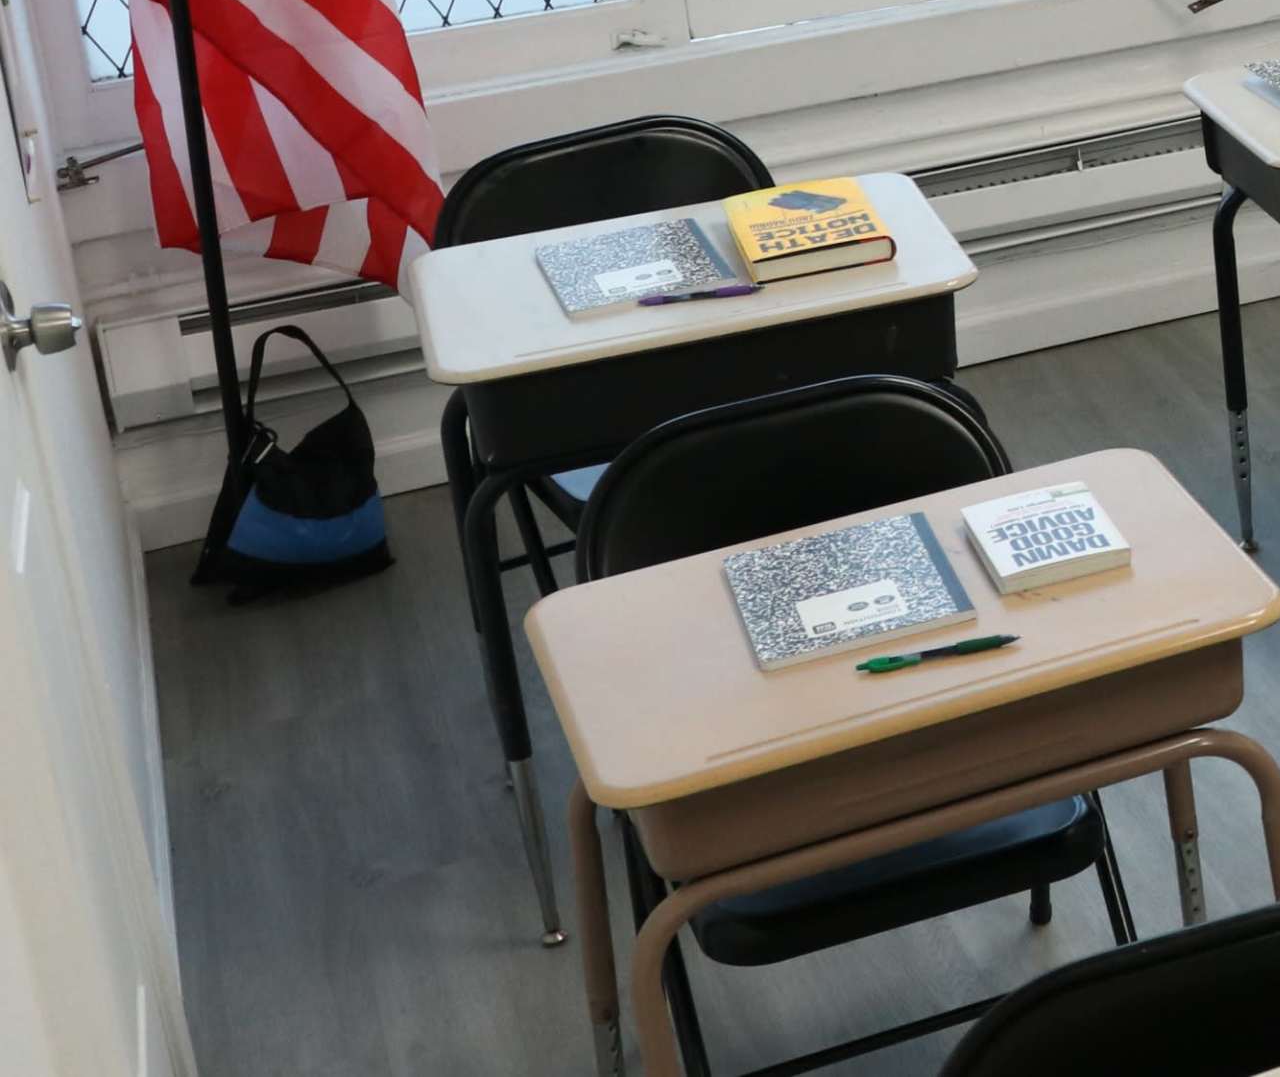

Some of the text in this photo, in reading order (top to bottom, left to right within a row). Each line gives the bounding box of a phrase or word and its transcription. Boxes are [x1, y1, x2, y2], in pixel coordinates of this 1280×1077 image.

[755, 211, 870, 243] NOTICE
[760, 220, 878, 254] DEATH
[987, 506, 1097, 544] ADVICE
[1011, 521, 1096, 553] GOOD
[1013, 532, 1112, 569] DAMN
